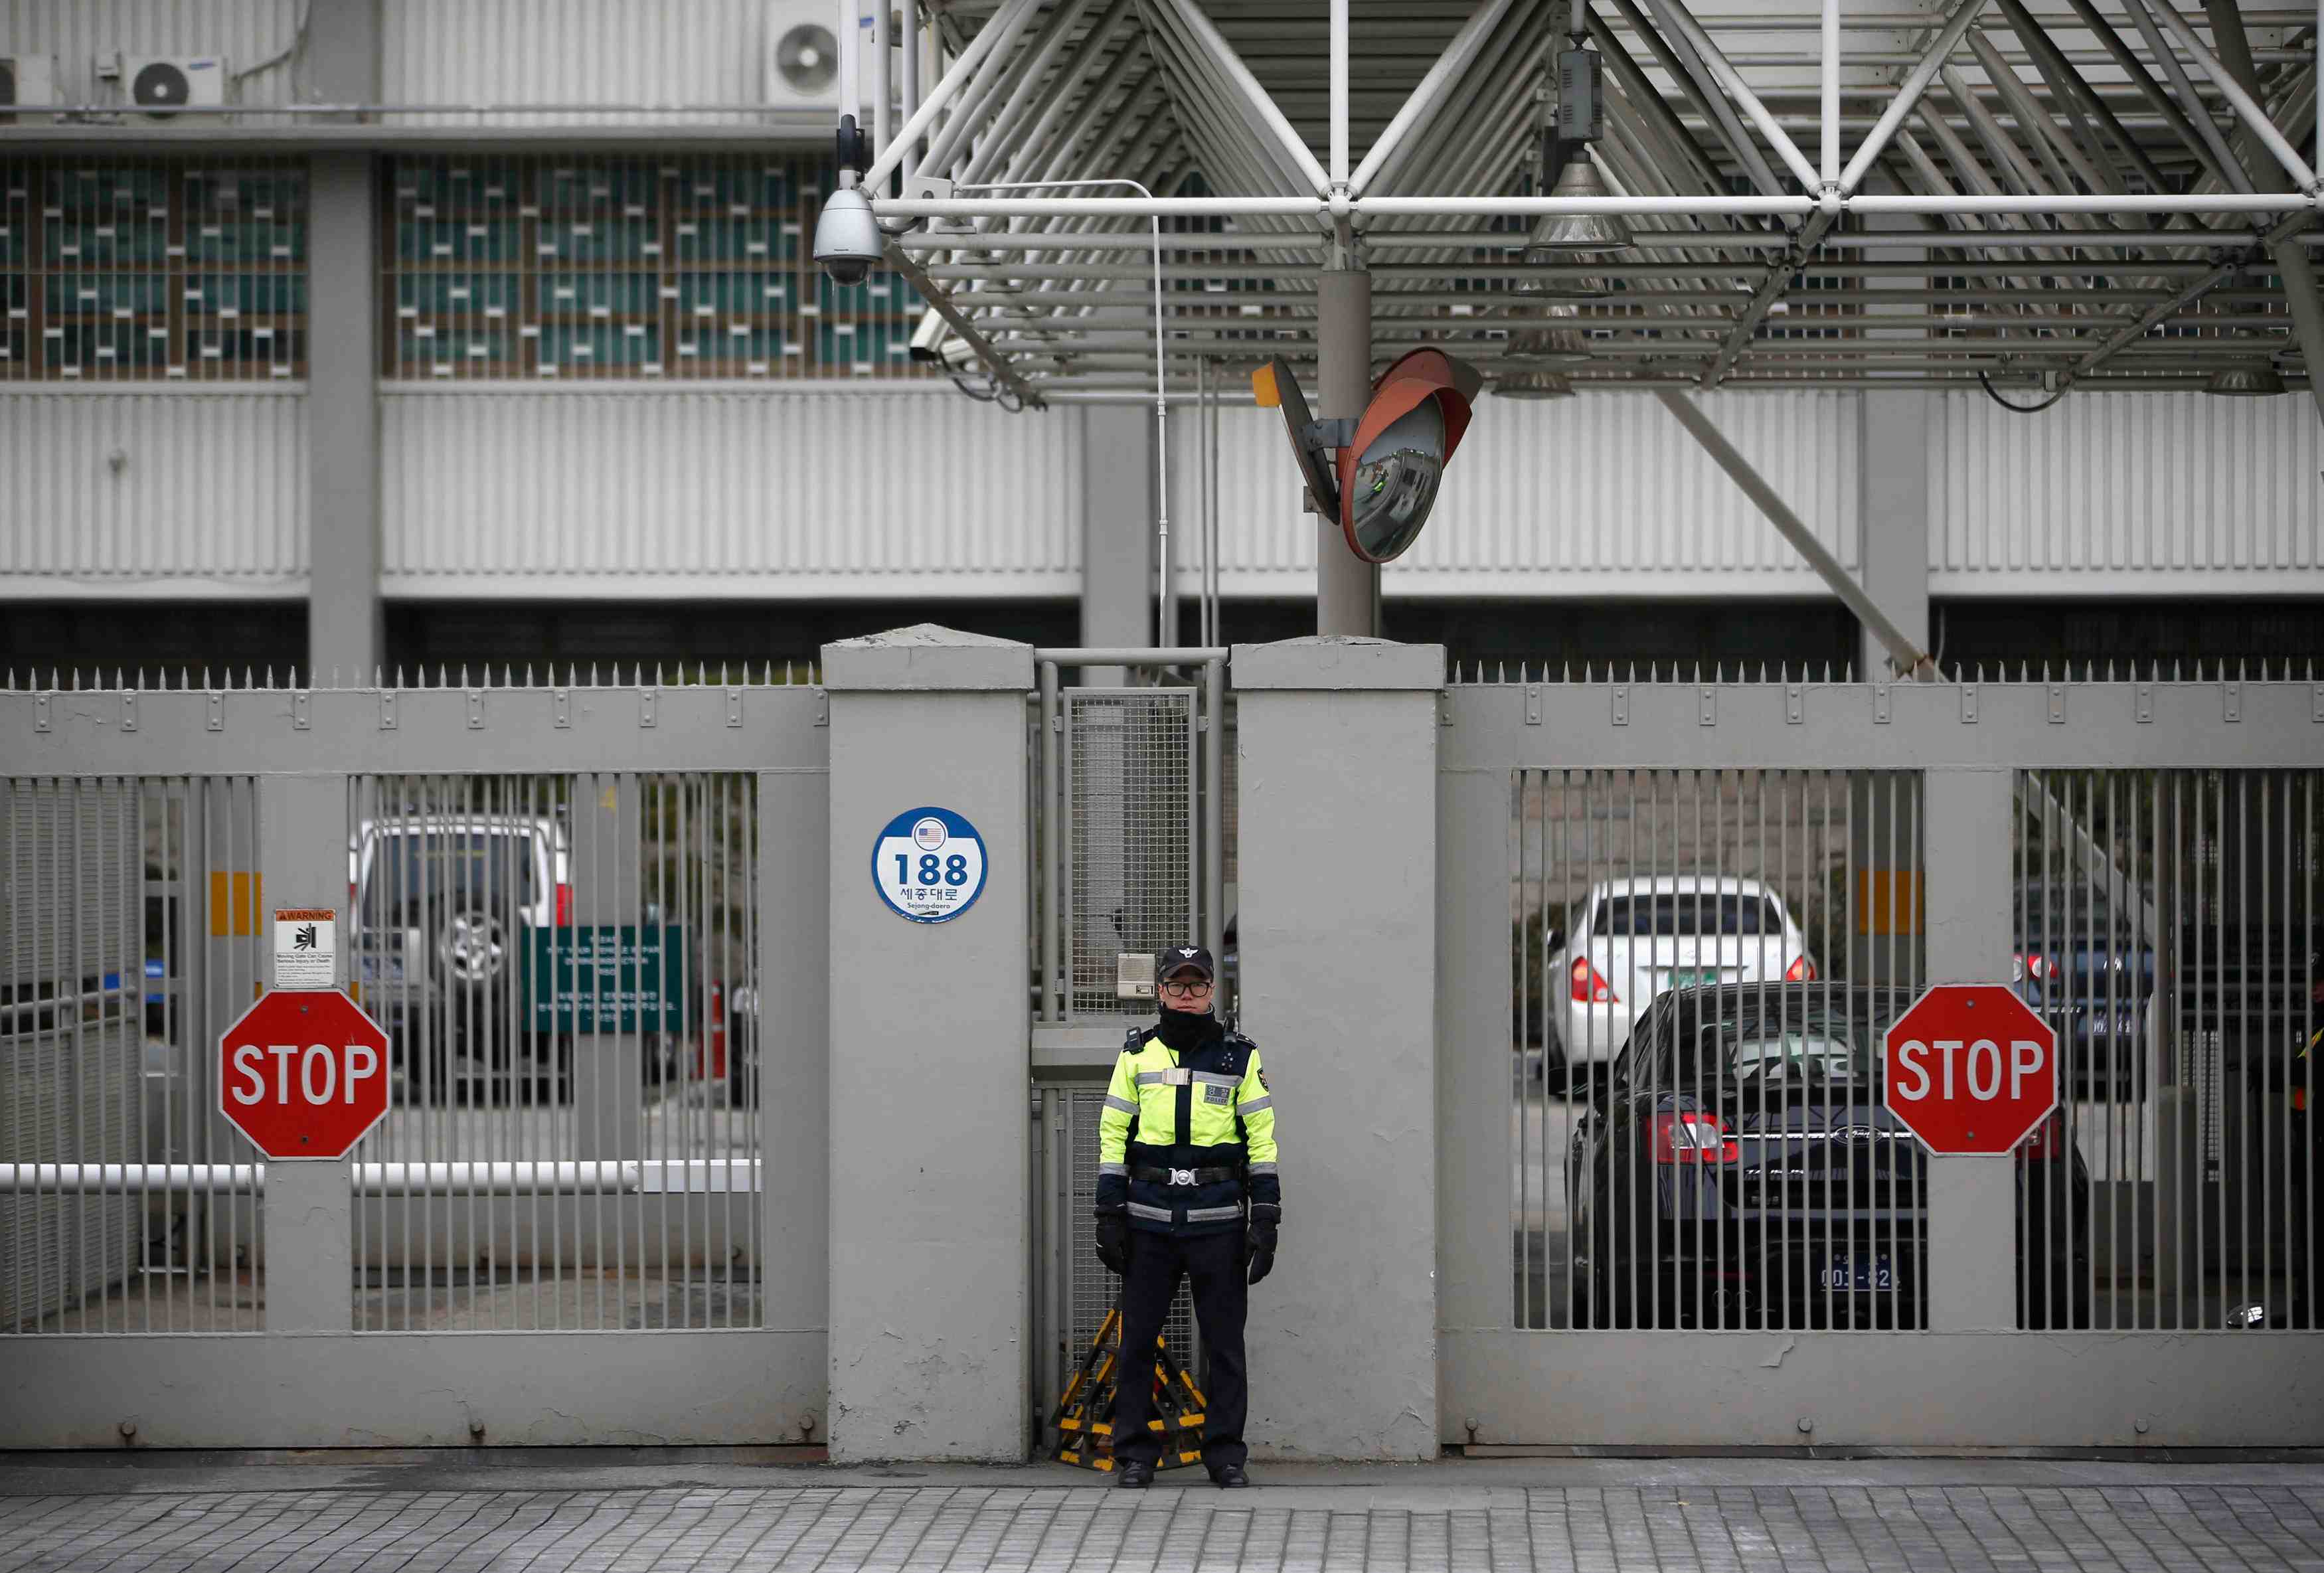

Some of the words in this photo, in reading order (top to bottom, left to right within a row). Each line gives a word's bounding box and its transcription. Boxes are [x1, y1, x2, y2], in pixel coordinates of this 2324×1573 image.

[895, 854, 967, 886] 188
[900, 888, 957, 900] 세종대로
[287, 912, 333, 920] WARNING
[231, 1044, 378, 1106] STOP
[1896, 1039, 2044, 1101] STOP
